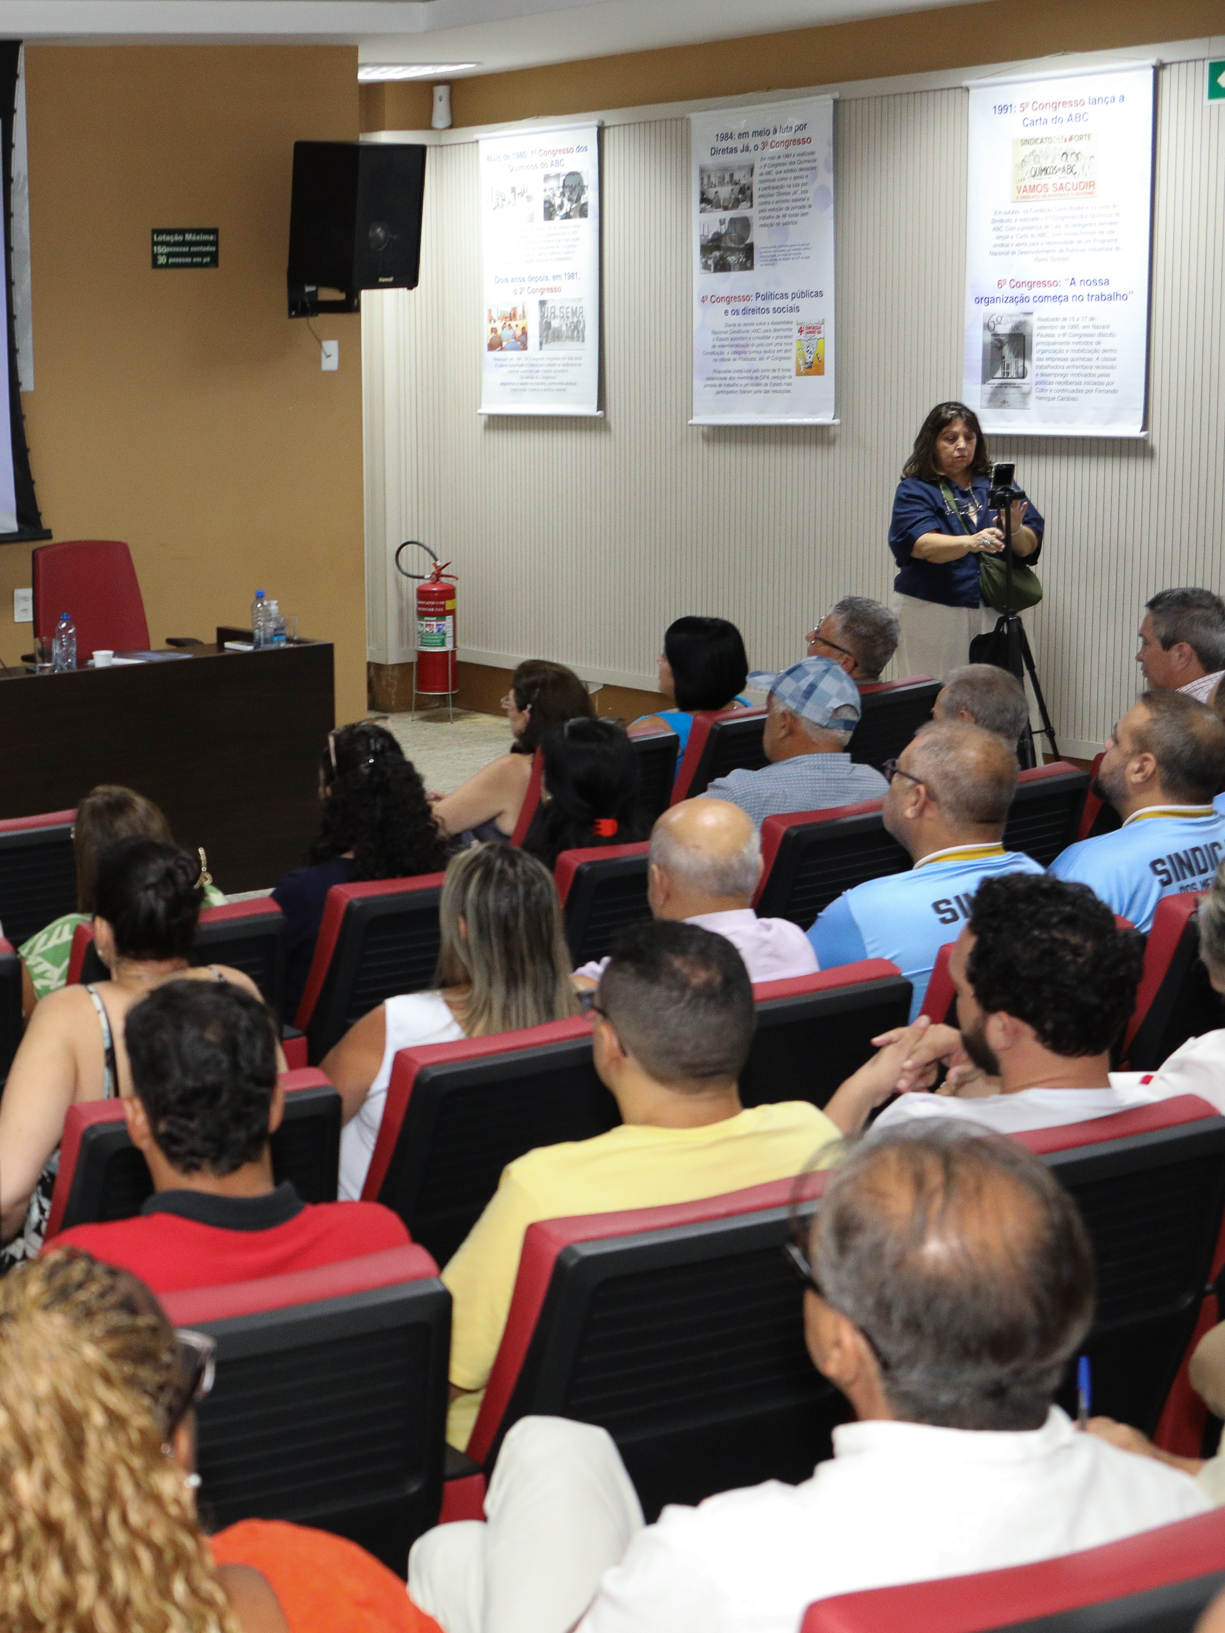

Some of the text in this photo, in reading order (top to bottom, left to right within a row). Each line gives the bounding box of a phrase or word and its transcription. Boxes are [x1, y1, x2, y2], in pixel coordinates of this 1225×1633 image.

[992, 104, 1017, 115] 1991:
[1032, 99, 1085, 113] Congresso
[1088, 96, 1116, 108] lança
[1119, 96, 1125, 104] a
[1022, 111, 1089, 128] Carta do ABC
[715, 131, 736, 142] 1984:
[738, 131, 749, 139] em
[752, 127, 770, 138] meio
[779, 124, 792, 134] luta
[794, 124, 808, 134] por
[710, 145, 738, 156] Diretas
[770, 137, 812, 149] Congresso
[1020, 136, 1052, 146] SINDICATO
[538, 148, 574, 158] Congresso
[550, 159, 564, 168] ABC
[1016, 180, 1095, 194] VAMOS SACUDIR
[1009, 279, 1061, 290] Congresso:
[1080, 278, 1110, 287] nossa
[527, 287, 562, 296] Congresso
[710, 295, 753, 305] Congresso:
[755, 291, 789, 301] Políticas
[791, 290, 824, 301] públicas
[974, 293, 1030, 306] organização
[1032, 294, 1069, 305] começa
[741, 306, 770, 315] direitos
[772, 304, 800, 314] sociais
[1149, 840, 1224, 887] SINDIC
